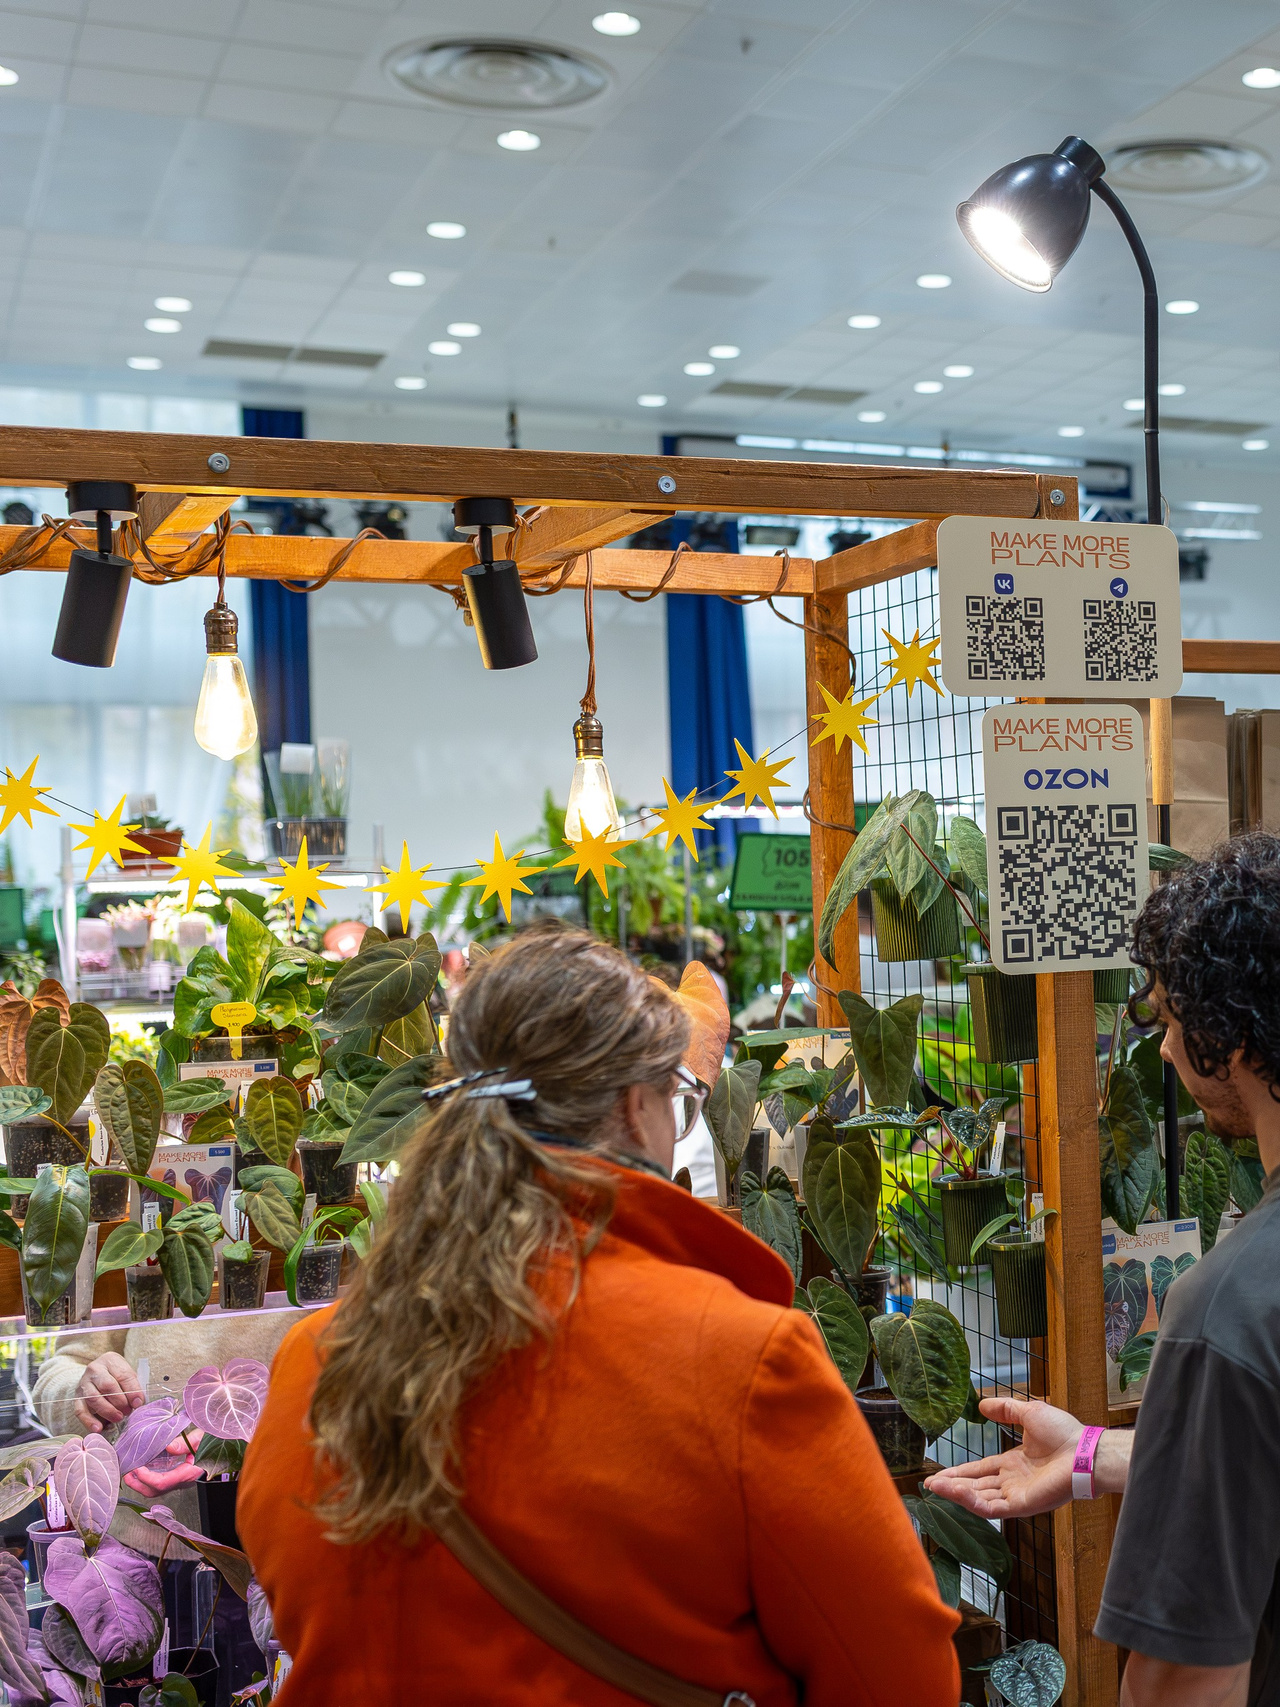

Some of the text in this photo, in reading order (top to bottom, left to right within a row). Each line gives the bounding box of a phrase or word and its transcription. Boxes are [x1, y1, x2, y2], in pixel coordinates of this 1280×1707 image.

[991, 532, 1129, 553] MAKE MORE
[991, 548, 1131, 570] PLANTS
[993, 718, 1133, 735] MAKE MORE
[993, 734, 1134, 752] PLANTS
[1023, 768, 1109, 790] OZON
[1116, 1231, 1170, 1244] MAKE MORE
[1117, 1238, 1170, 1250] PLANTS
